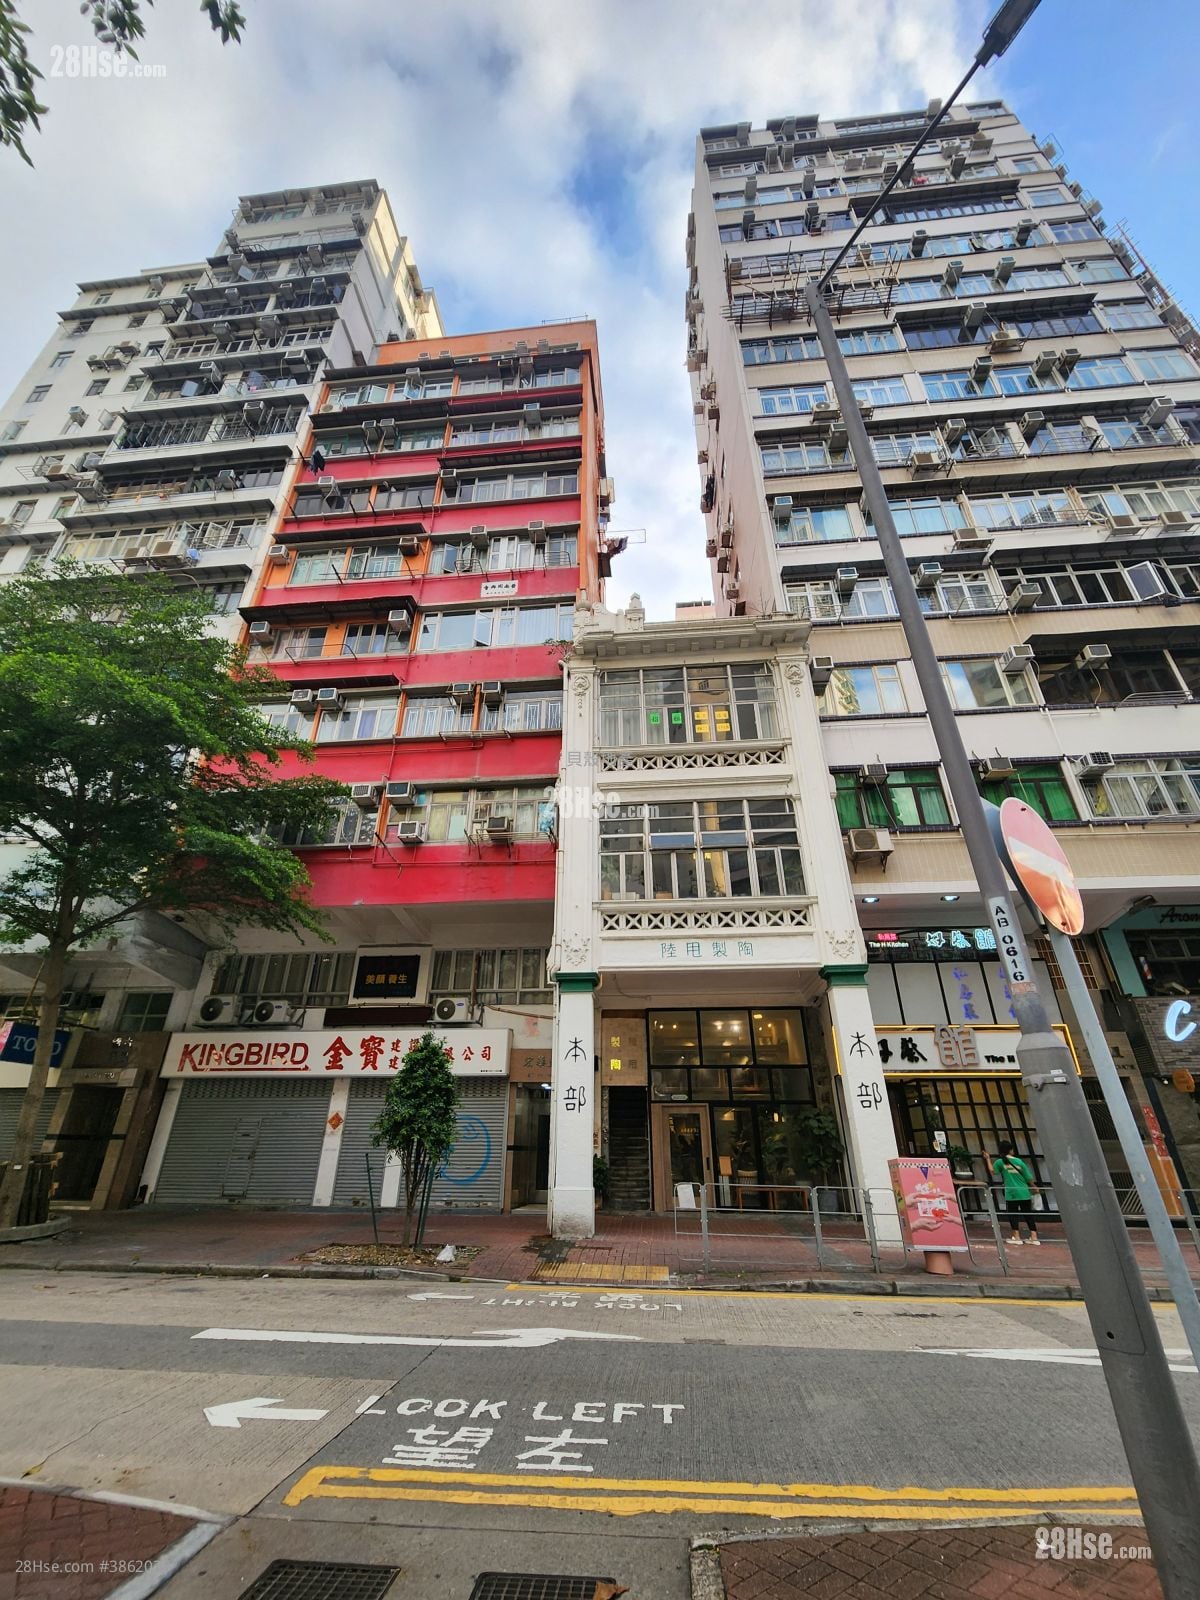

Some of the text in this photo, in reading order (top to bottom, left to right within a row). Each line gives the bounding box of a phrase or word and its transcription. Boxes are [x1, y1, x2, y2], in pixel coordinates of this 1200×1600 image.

[1002, 935, 1025, 982] 0616
[177, 1043, 309, 1071] KINGBIRD
[564, 1036, 587, 1114] 本部
[849, 1031, 883, 1111] 本部
[985, 1055, 1005, 1063] The
[355, 1395, 686, 1424] LOOK LEFT
